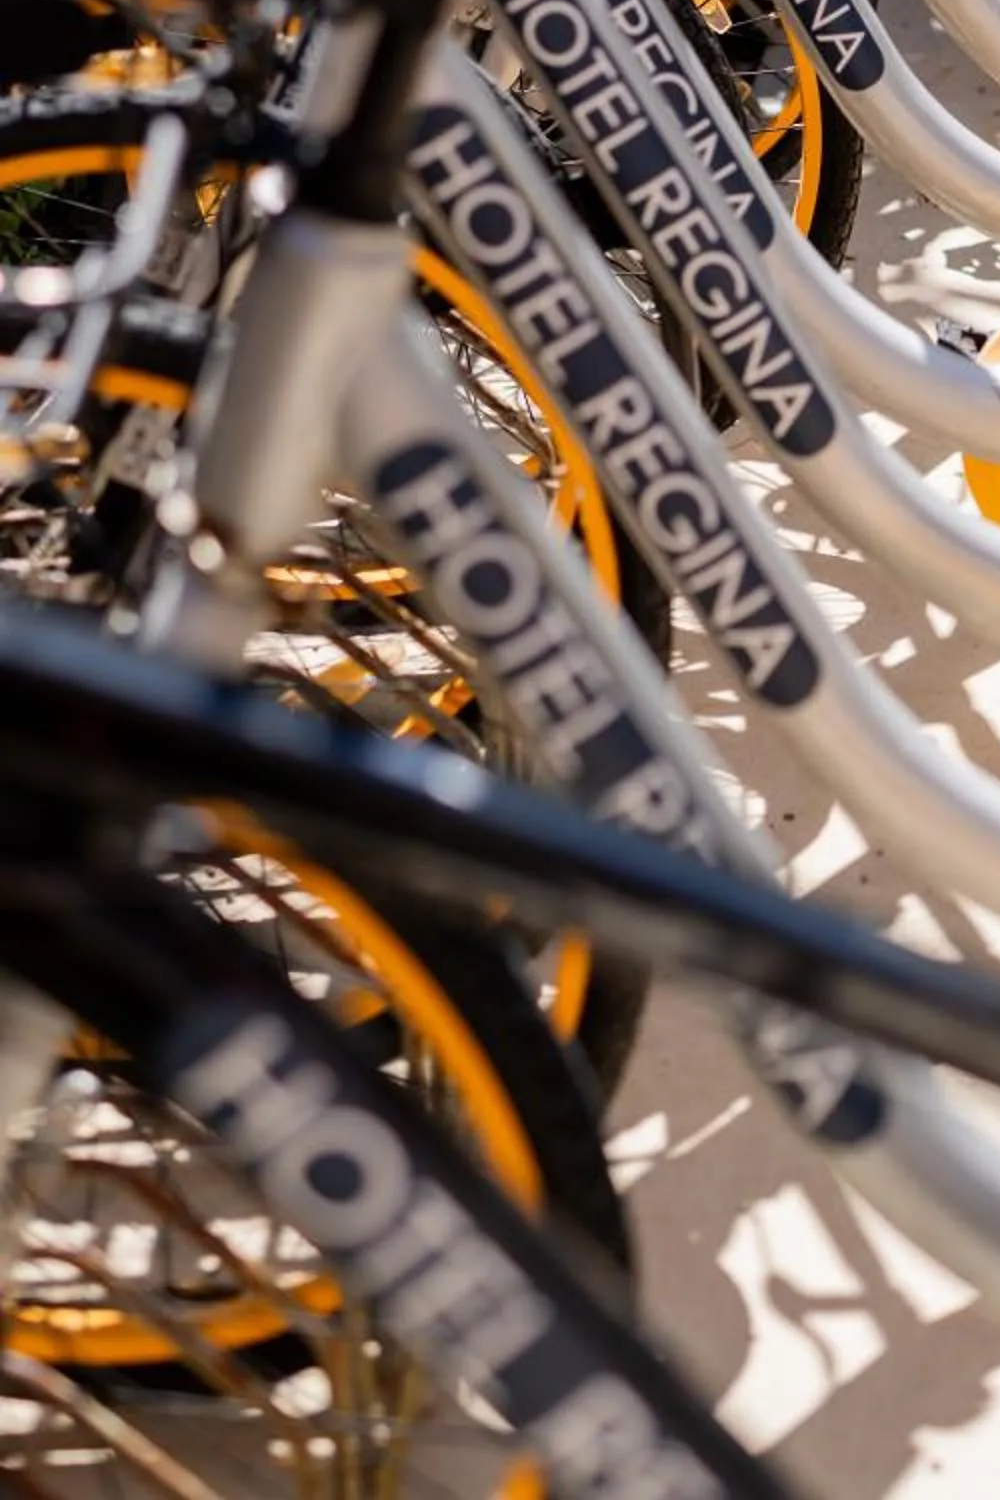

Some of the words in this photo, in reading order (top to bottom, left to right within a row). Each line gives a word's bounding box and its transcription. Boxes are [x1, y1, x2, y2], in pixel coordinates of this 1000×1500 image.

[405, 120, 602, 393] HOTEL
[571, 373, 797, 691] REGINA
[629, 165, 813, 440] REGINA
[391, 446, 617, 779] HOTEL
